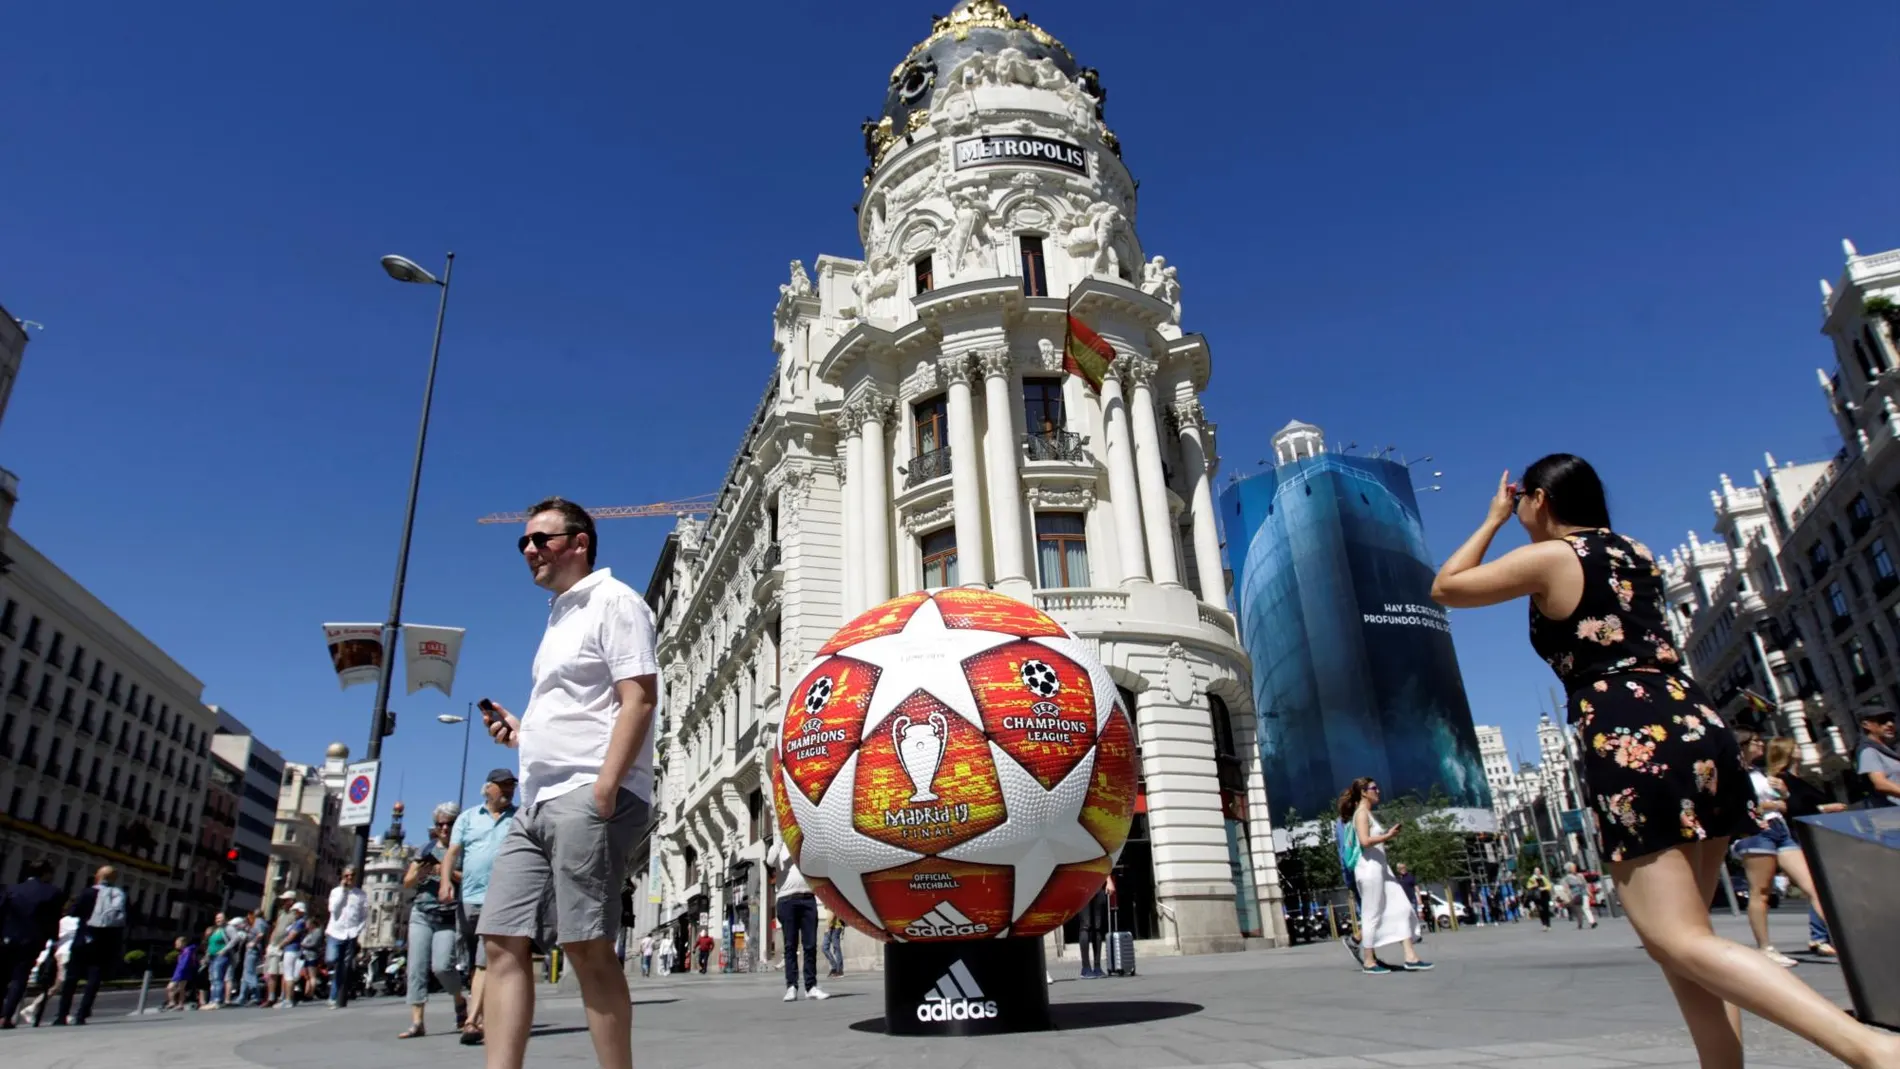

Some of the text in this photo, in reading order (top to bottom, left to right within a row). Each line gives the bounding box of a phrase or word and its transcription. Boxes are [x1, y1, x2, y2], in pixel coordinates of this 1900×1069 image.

[961, 140, 1083, 166] METROPOLIS
[1384, 603, 1403, 612] HAY
[1405, 604, 1440, 617] SECRETOS
[1363, 614, 1421, 625] PROFUNDOS
[1033, 703, 1060, 717] UEFA
[803, 719, 822, 732] UEFA
[1003, 716, 1087, 734] CHAMPIONS
[786, 729, 846, 753] CHAMPIONS
[1027, 731, 1070, 743] LEAGUE
[797, 746, 827, 760] LEAGUE
[954, 803, 969, 823] 19
[902, 827, 953, 838] FINAL
[914, 873, 952, 881] OFFICIAL
[909, 880, 960, 890] MATCHBALL
[904, 923, 989, 937] adidas
[917, 998, 998, 1022] adidas
